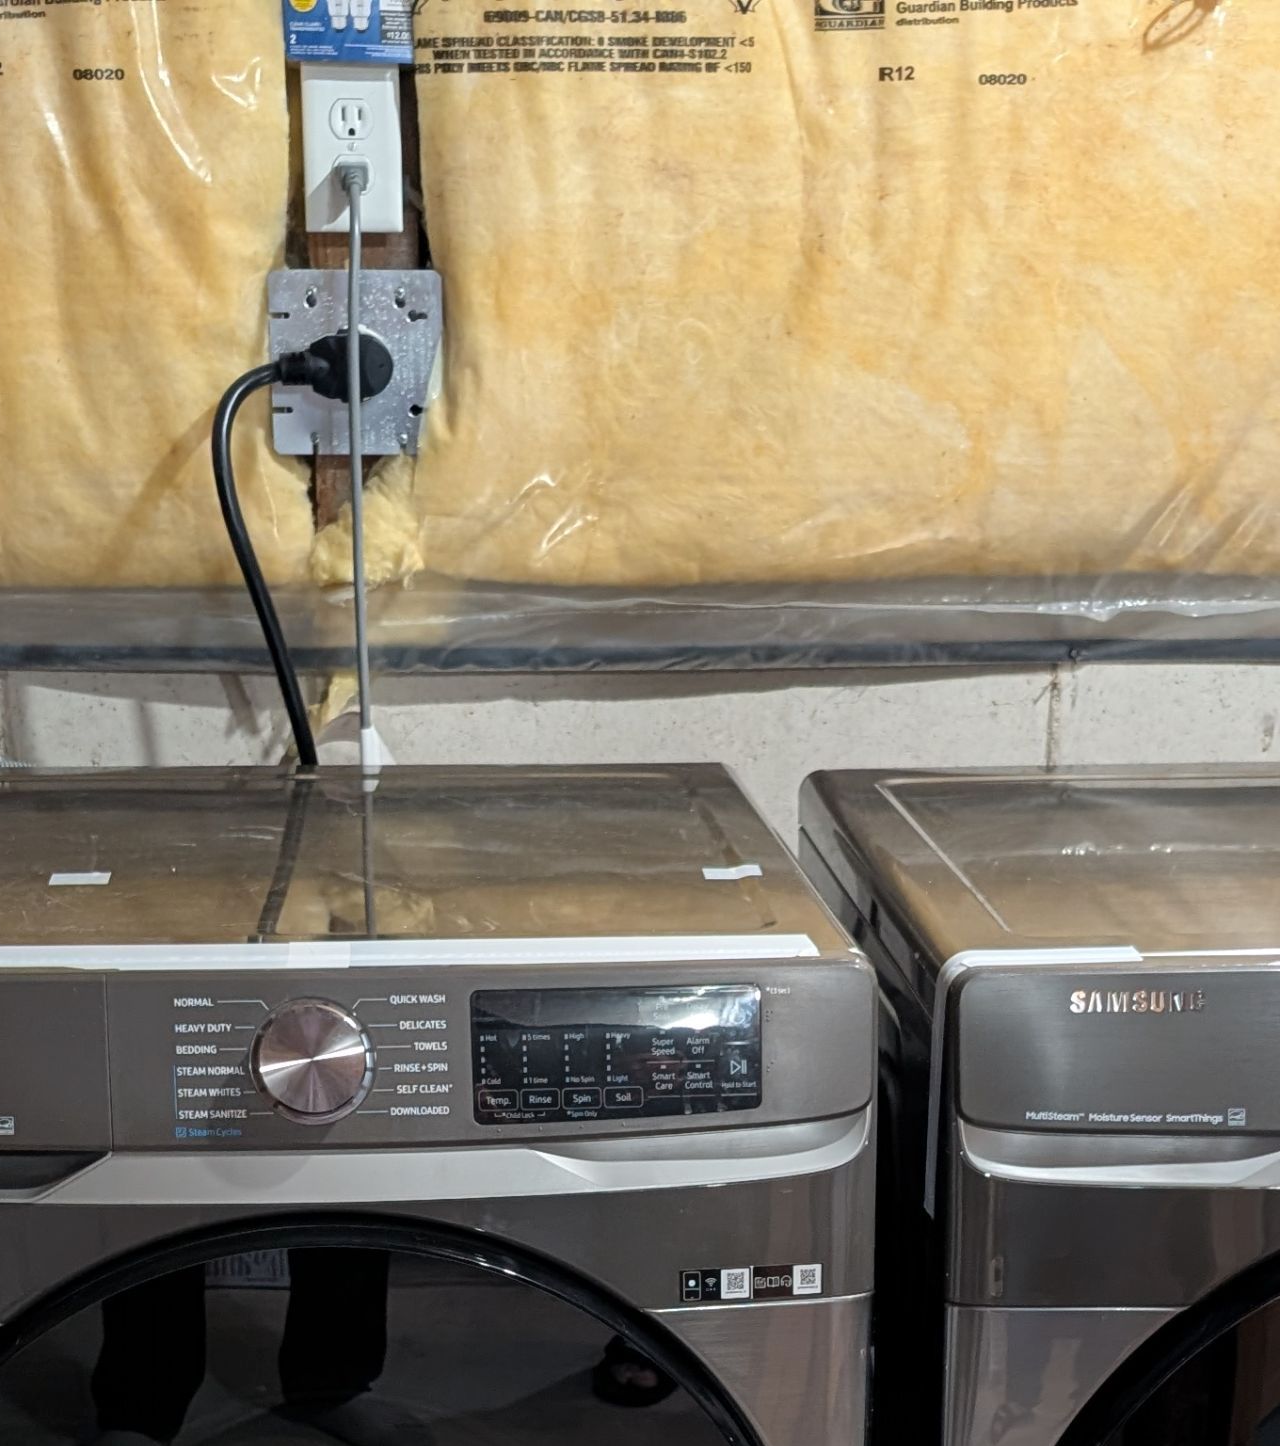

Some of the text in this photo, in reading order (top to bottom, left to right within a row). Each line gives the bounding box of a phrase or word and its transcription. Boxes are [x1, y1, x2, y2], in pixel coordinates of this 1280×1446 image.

[896, 1, 956, 13] Guardian
[959, 0, 1014, 13] Building
[724, 62, 752, 73] <150
[72, 68, 125, 81] 08020
[878, 66, 915, 82] R12
[978, 74, 1027, 85] 08020
[173, 998, 214, 1007] NORMAL
[389, 995, 446, 1005] QUICK WASH
[1070, 990, 1206, 1013] SAMSUNG
[174, 1024, 232, 1033] HEAVY DUTY
[399, 1020, 447, 1030] DELICATES
[414, 1041, 448, 1050] TOWELS
[652, 1038, 674, 1046] Super
[686, 1037, 710, 1045] Alarm
[176, 1045, 217, 1055] BEDDING
[651, 1047, 676, 1056] Speed
[691, 1046, 705, 1055] Off
[176, 1066, 245, 1076] STEAM NORMAL
[394, 1063, 421, 1073] RINSE
[427, 1063, 448, 1072] SPIN
[652, 1072, 676, 1081] Smart
[687, 1072, 711, 1080] Smart
[396, 1085, 418, 1094] SELF
[655, 1082, 673, 1090] Care
[685, 1081, 713, 1089] Control
[177, 1088, 241, 1098] STEAM WHITES
[615, 1093, 632, 1102] Soil
[486, 1096, 512, 1105] Temp.
[529, 1095, 553, 1104] Rinse
[572, 1094, 592, 1104] Spin
[178, 1109, 248, 1120] STEAM SANITIZE
[390, 1106, 450, 1116] DOWNLOADED
[1088, 1112, 1129, 1123] Moisture
[1129, 1113, 1163, 1123] Sensor
[1166, 1113, 1223, 1125] SmartThings
[188, 1127, 242, 1137] Steam Cycles
